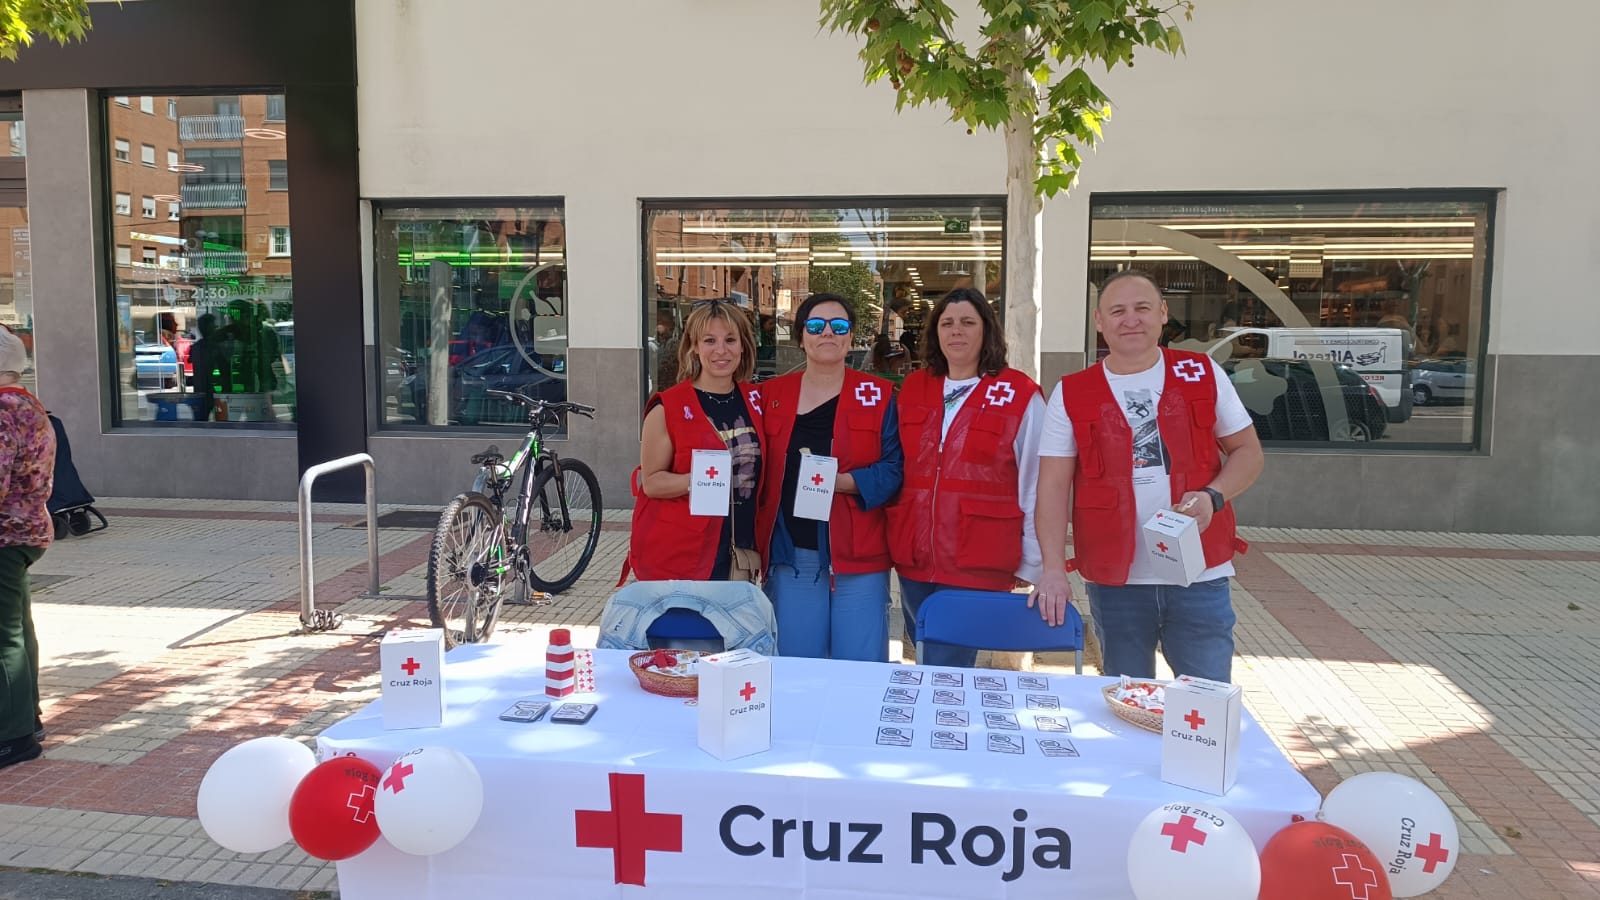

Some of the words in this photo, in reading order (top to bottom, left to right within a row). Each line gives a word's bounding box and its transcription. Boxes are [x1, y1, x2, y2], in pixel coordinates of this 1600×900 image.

[191, 287, 227, 298] 21:30
[413, 678, 433, 687] Roja
[729, 707, 747, 716] Cruz
[748, 702, 766, 712] Roja
[1171, 729, 1193, 741] Cruz
[1195, 735, 1217, 747] Roja
[1163, 803, 1191, 814] Roja
[1193, 808, 1225, 827] Cruz
[1400, 817, 1416, 848] Cruz
[719, 804, 883, 864] Cruz
[911, 808, 1072, 882] Roja
[1389, 850, 1412, 875] Roja
